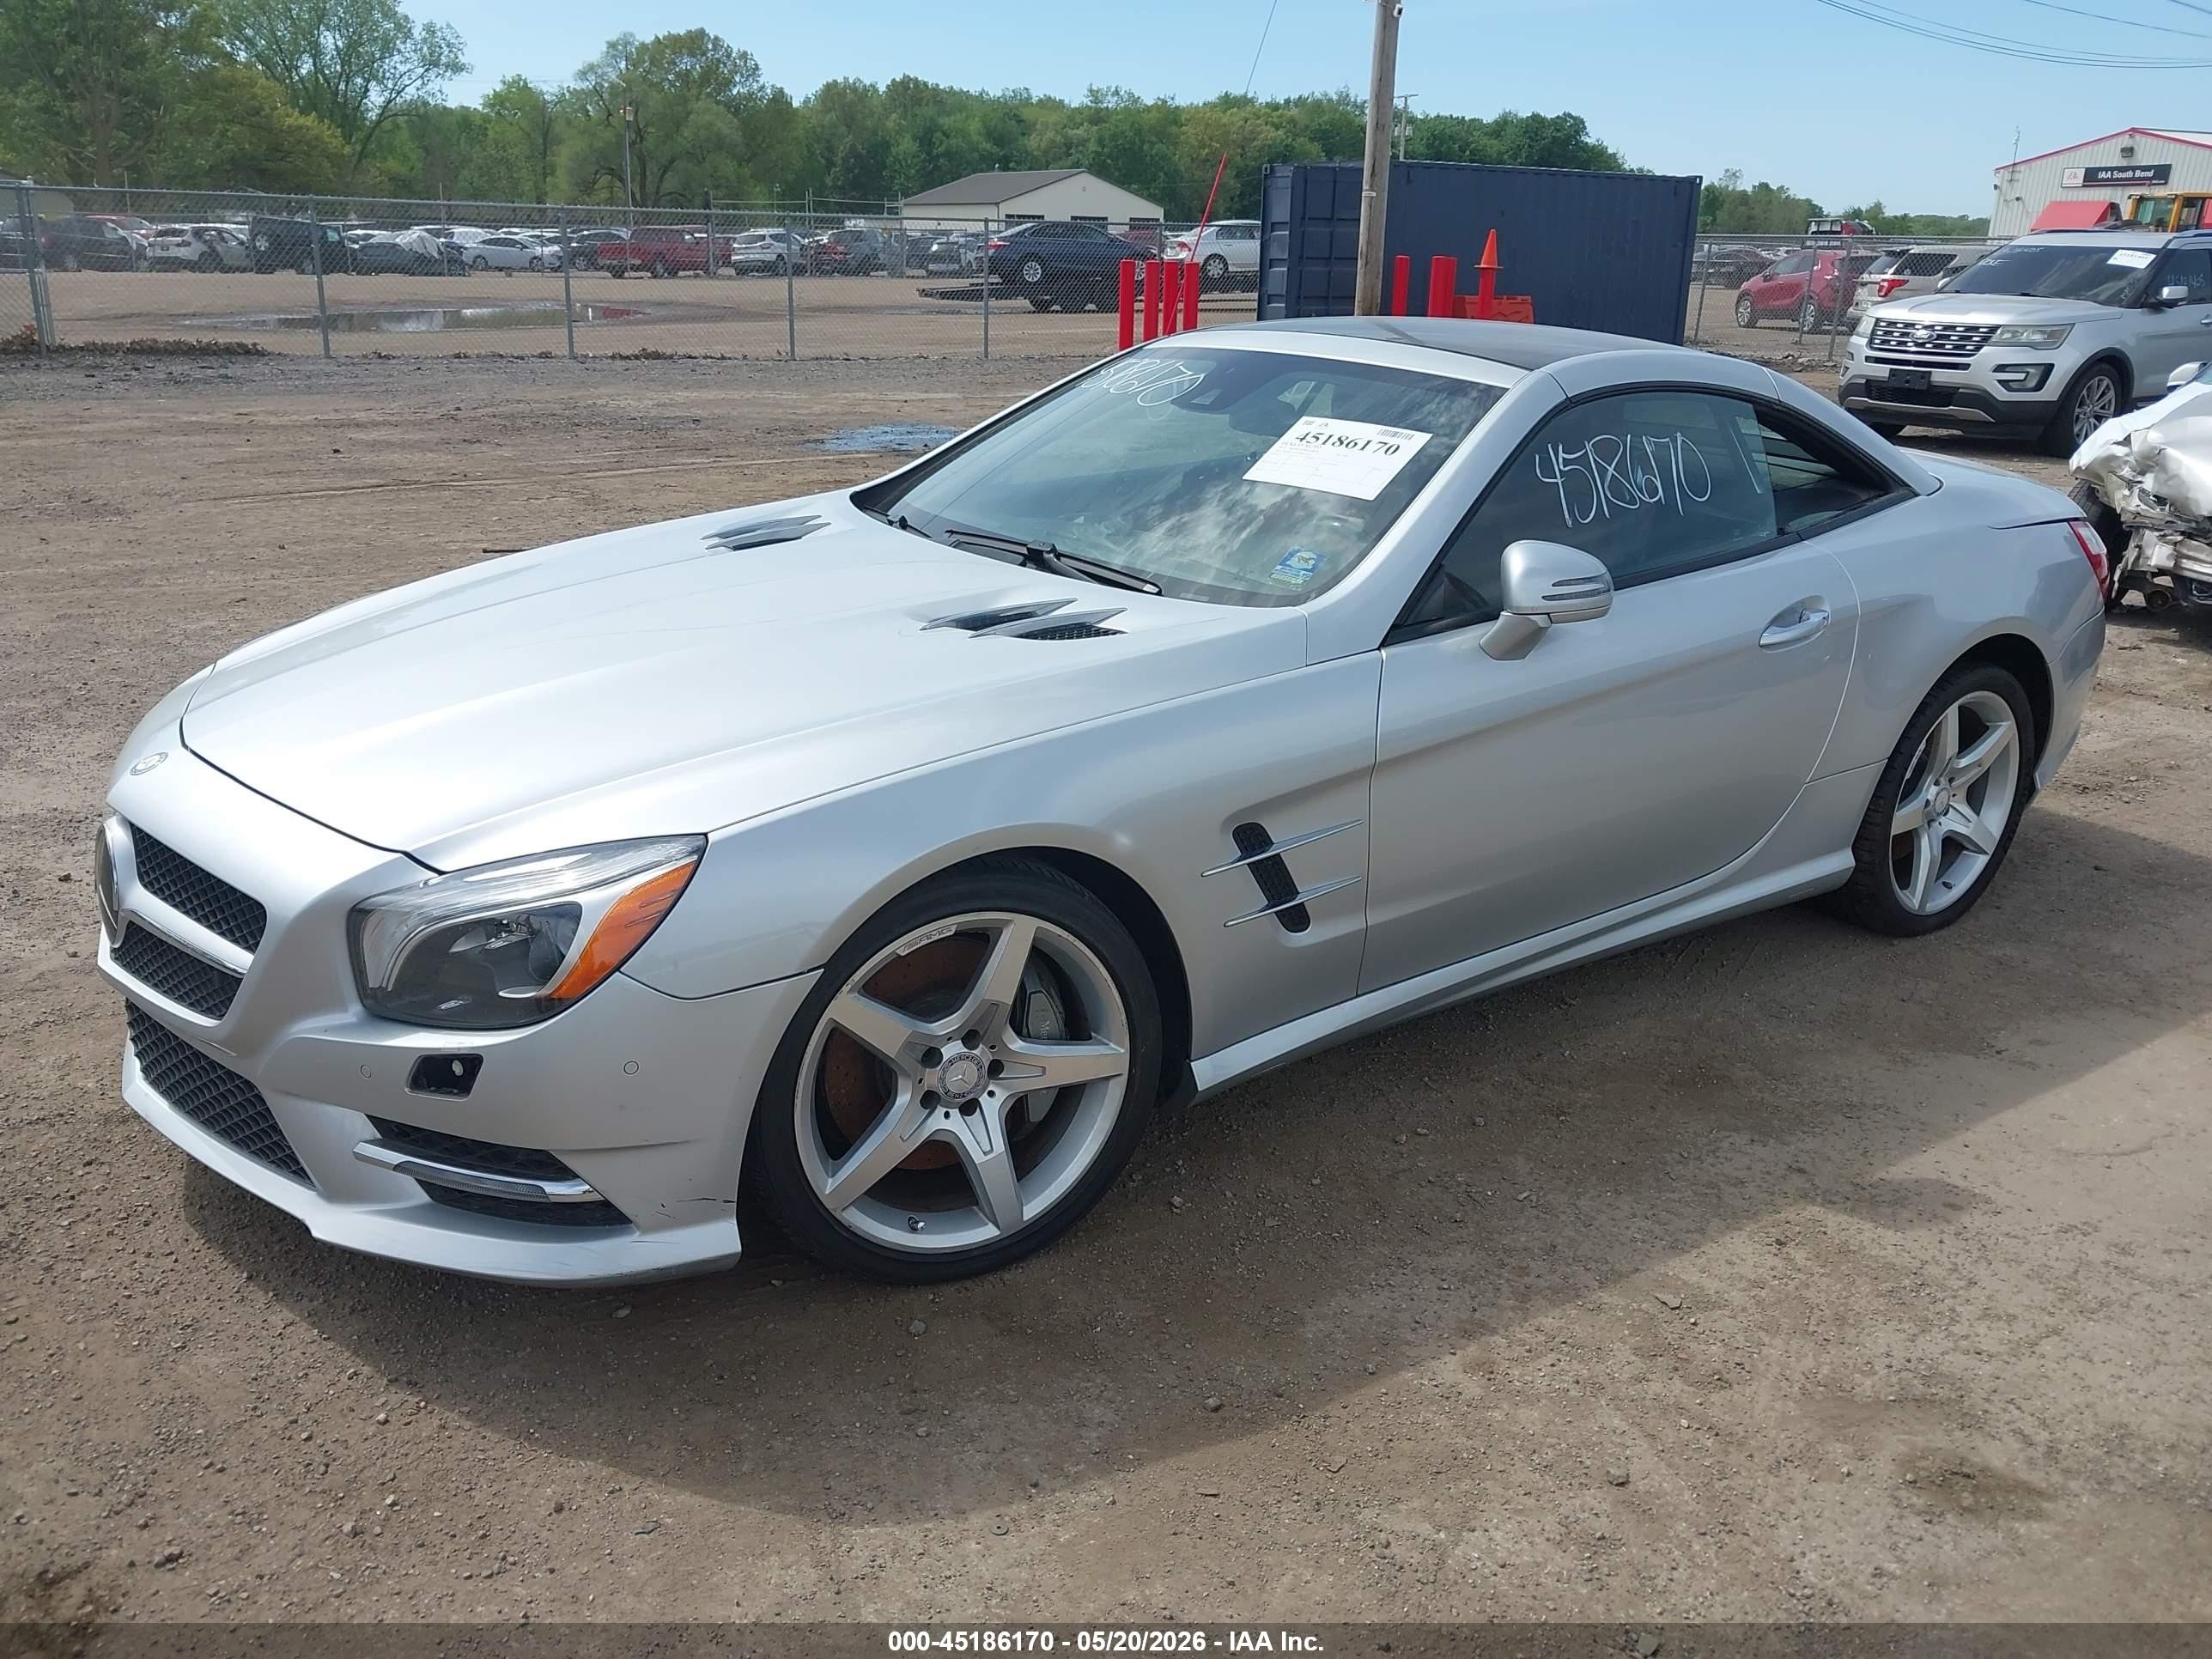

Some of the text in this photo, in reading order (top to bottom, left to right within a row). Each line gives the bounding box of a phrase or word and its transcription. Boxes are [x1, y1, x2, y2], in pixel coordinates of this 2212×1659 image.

[2098, 168, 2154, 179] IAA South Bend
[1295, 431, 1401, 457] 45186170
